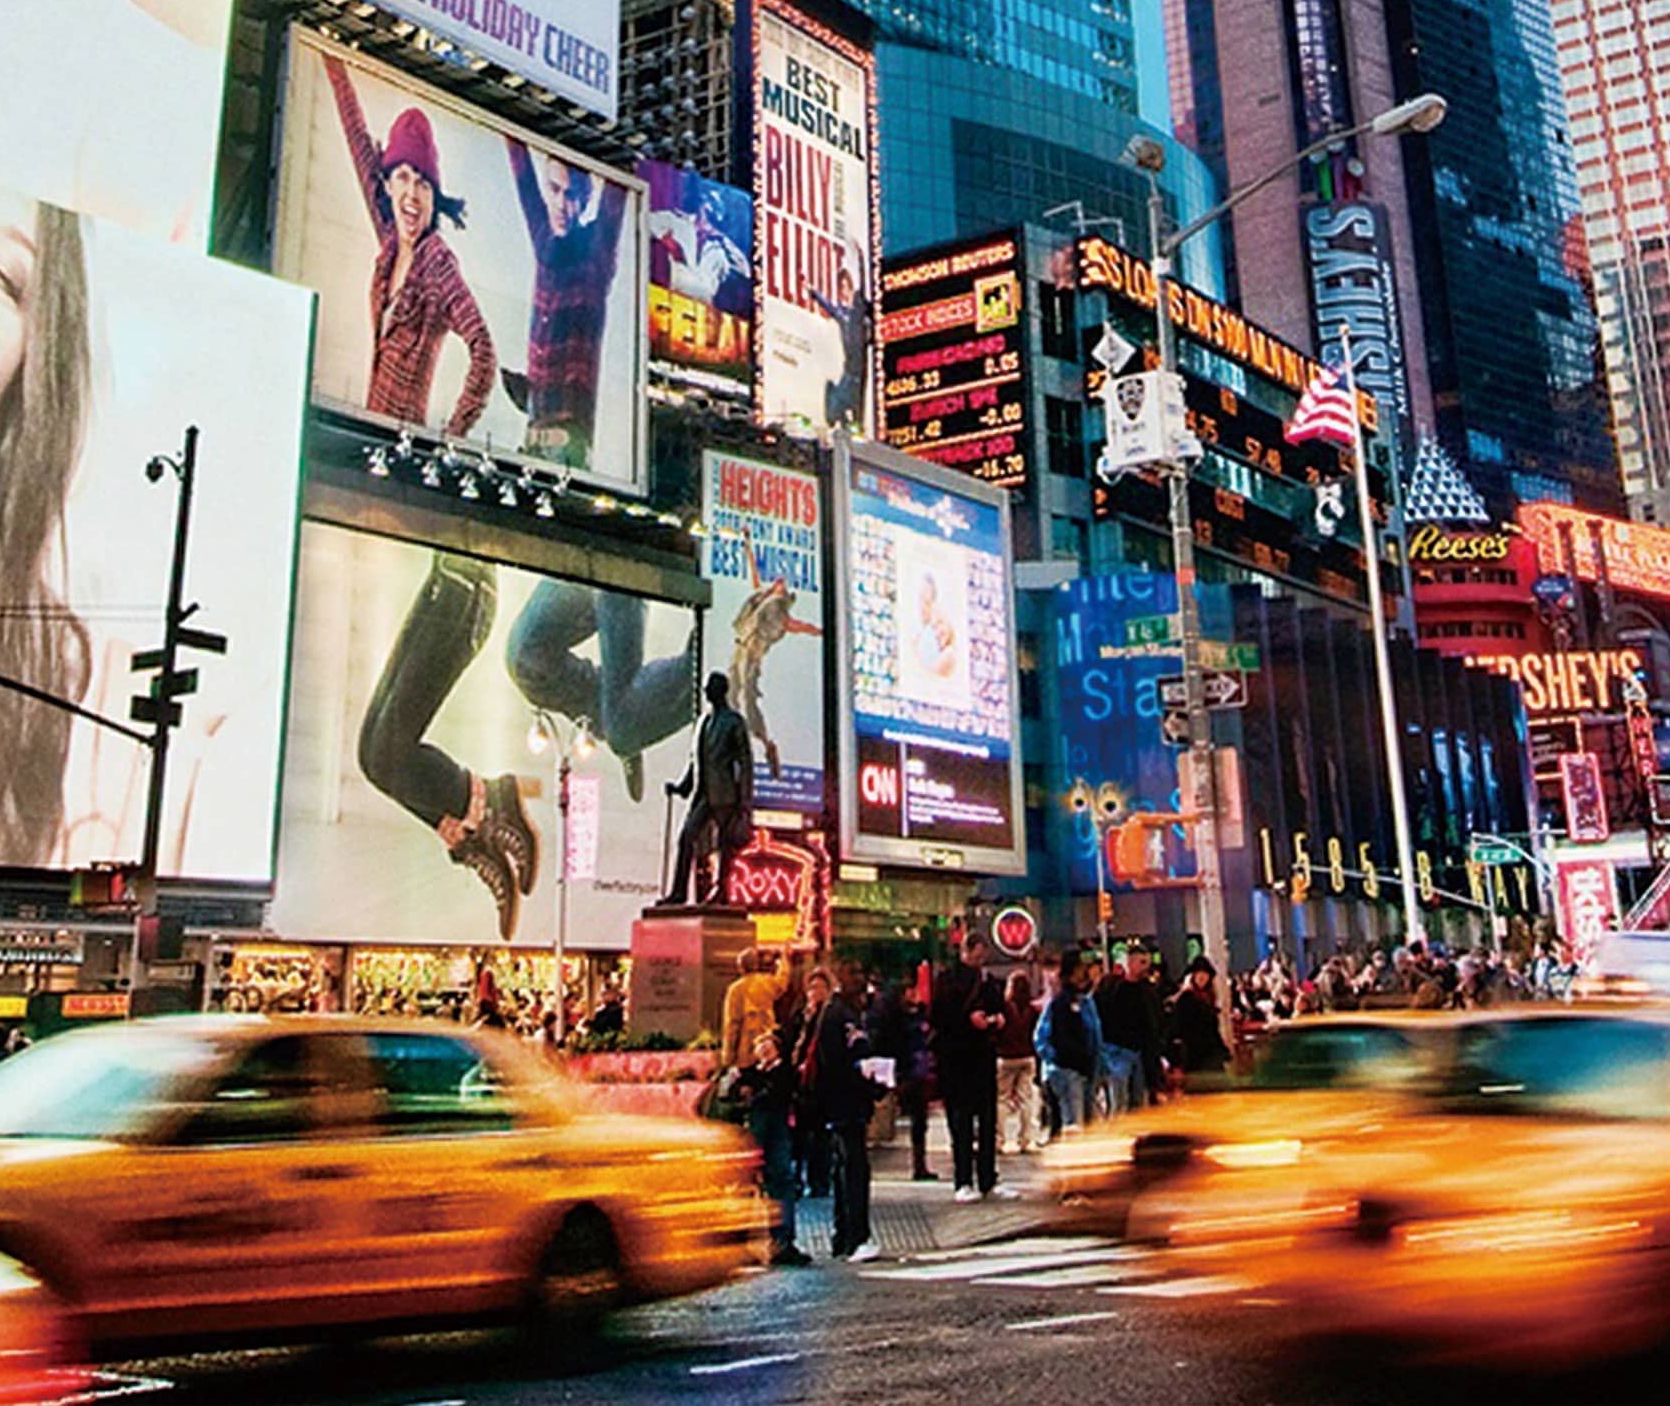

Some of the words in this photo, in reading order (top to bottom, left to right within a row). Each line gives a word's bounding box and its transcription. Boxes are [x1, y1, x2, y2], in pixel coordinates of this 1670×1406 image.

[543, 20, 610, 94] CHEER
[786, 56, 841, 111] BEST
[762, 78, 865, 162] MUSICAL
[765, 124, 831, 235] BILLY
[766, 208, 847, 319] ELLIOT
[1308, 206, 1393, 406] SHEY'S
[719, 460, 817, 527] HEIGHTS
[712, 534, 748, 580] BEST
[753, 542, 818, 593] MUSICAL
[1409, 526, 1509, 562] Reese's
[1260, 827, 1379, 899] 1585
